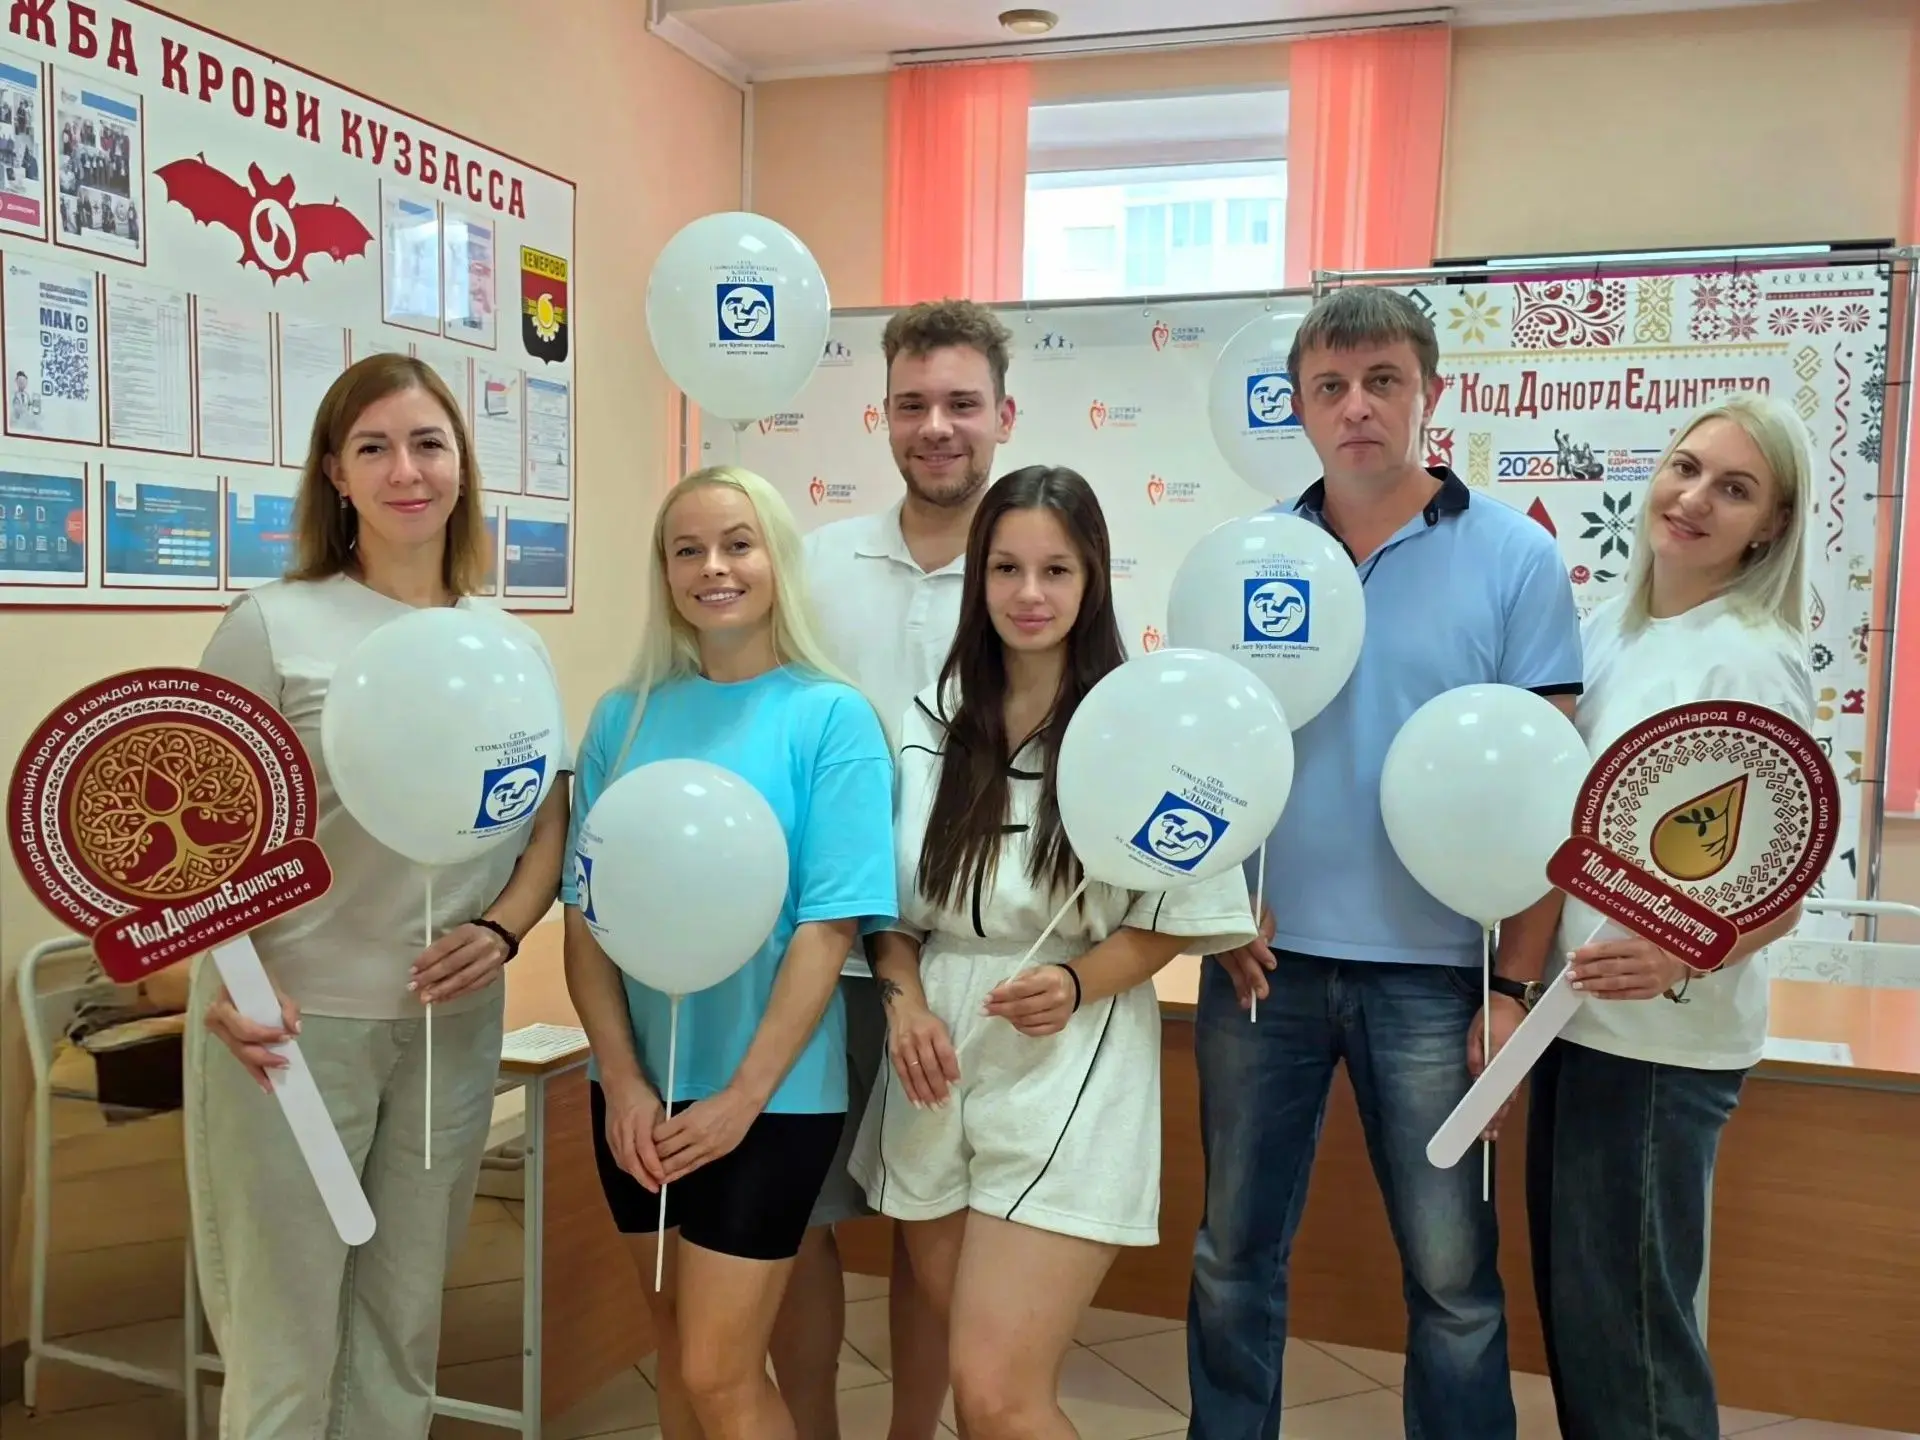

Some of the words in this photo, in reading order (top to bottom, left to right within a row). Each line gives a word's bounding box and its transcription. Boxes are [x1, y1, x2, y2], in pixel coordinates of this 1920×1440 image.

[160, 36, 322, 145] КРОВИ
[341, 109, 526, 219] КУЗБАССА
[523, 250, 567, 278] КЕМЕРОВО
[725, 275, 764, 283] УЛЫБКА
[40, 307, 73, 331] MAX
[1171, 327, 1205, 335] СЛУЖБА
[1498, 456, 1554, 477] 2026
[1607, 449, 1628, 457] ГОД
[1255, 570, 1300, 578] УЛЫБКА
[1736, 711, 1746, 722] В
[509, 730, 527, 740] СЕТЬ
[1750, 715, 1801, 749] каждой
[63, 711, 78, 725] В
[78, 680, 144, 715] каждой
[148, 679, 200, 692] капле
[216, 689, 252, 714] сила
[252, 711, 294, 761] нашего
[289, 763, 306, 837] единства
[497, 750, 540, 767] УЛЫБКА
[1797, 747, 1823, 785] капле
[1206, 775, 1224, 788] СЕТЬ
[1181, 788, 1225, 817] УЛЫБКА
[1819, 796, 1828, 830] сила
[1797, 833, 1826, 882] нашего
[1571, 877, 1662, 935] ВСЕРОССИЙСКАЯ
[1665, 934, 1703, 959] АКЦИЯ
[1736, 883, 1797, 927] единства
[141, 906, 261, 965] ВСЕРОССИЙСКАЯ
[266, 882, 311, 908] АКЦИЯ
